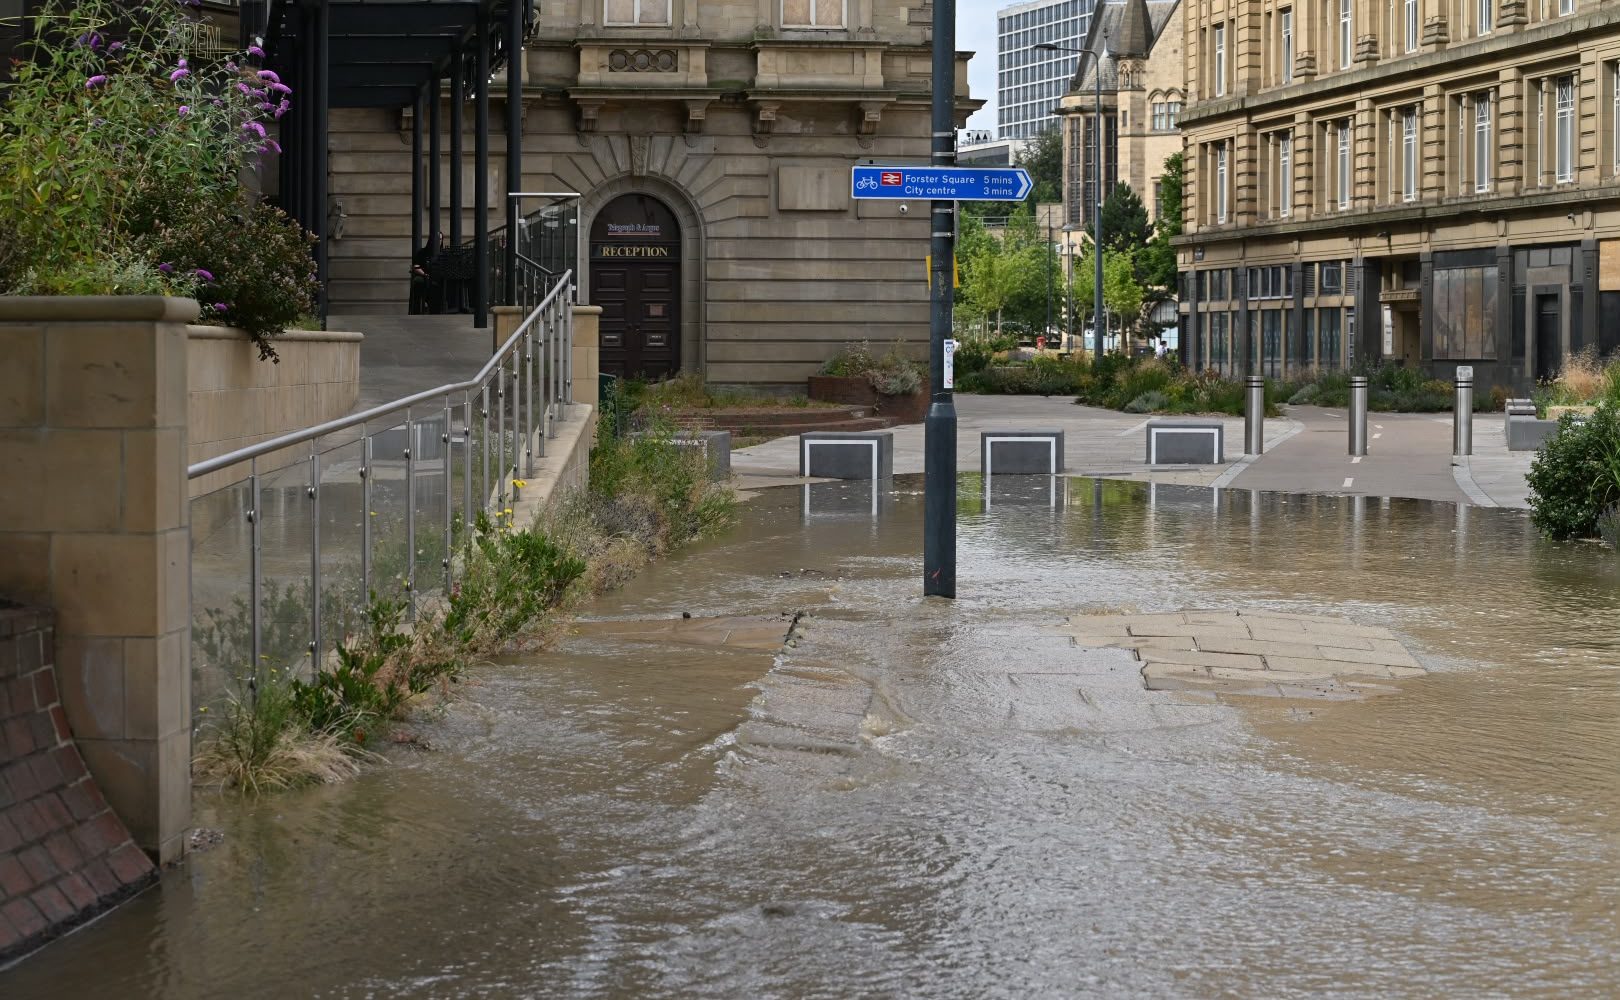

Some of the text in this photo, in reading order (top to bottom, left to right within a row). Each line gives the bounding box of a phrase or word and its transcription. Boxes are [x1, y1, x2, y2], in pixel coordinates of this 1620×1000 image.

[905, 174, 976, 185] Forster Square
[983, 175, 1013, 185] 5 mins
[904, 185, 956, 196] City centre
[983, 186, 1013, 196] 3 mins
[602, 246, 669, 257] RECEPTION
